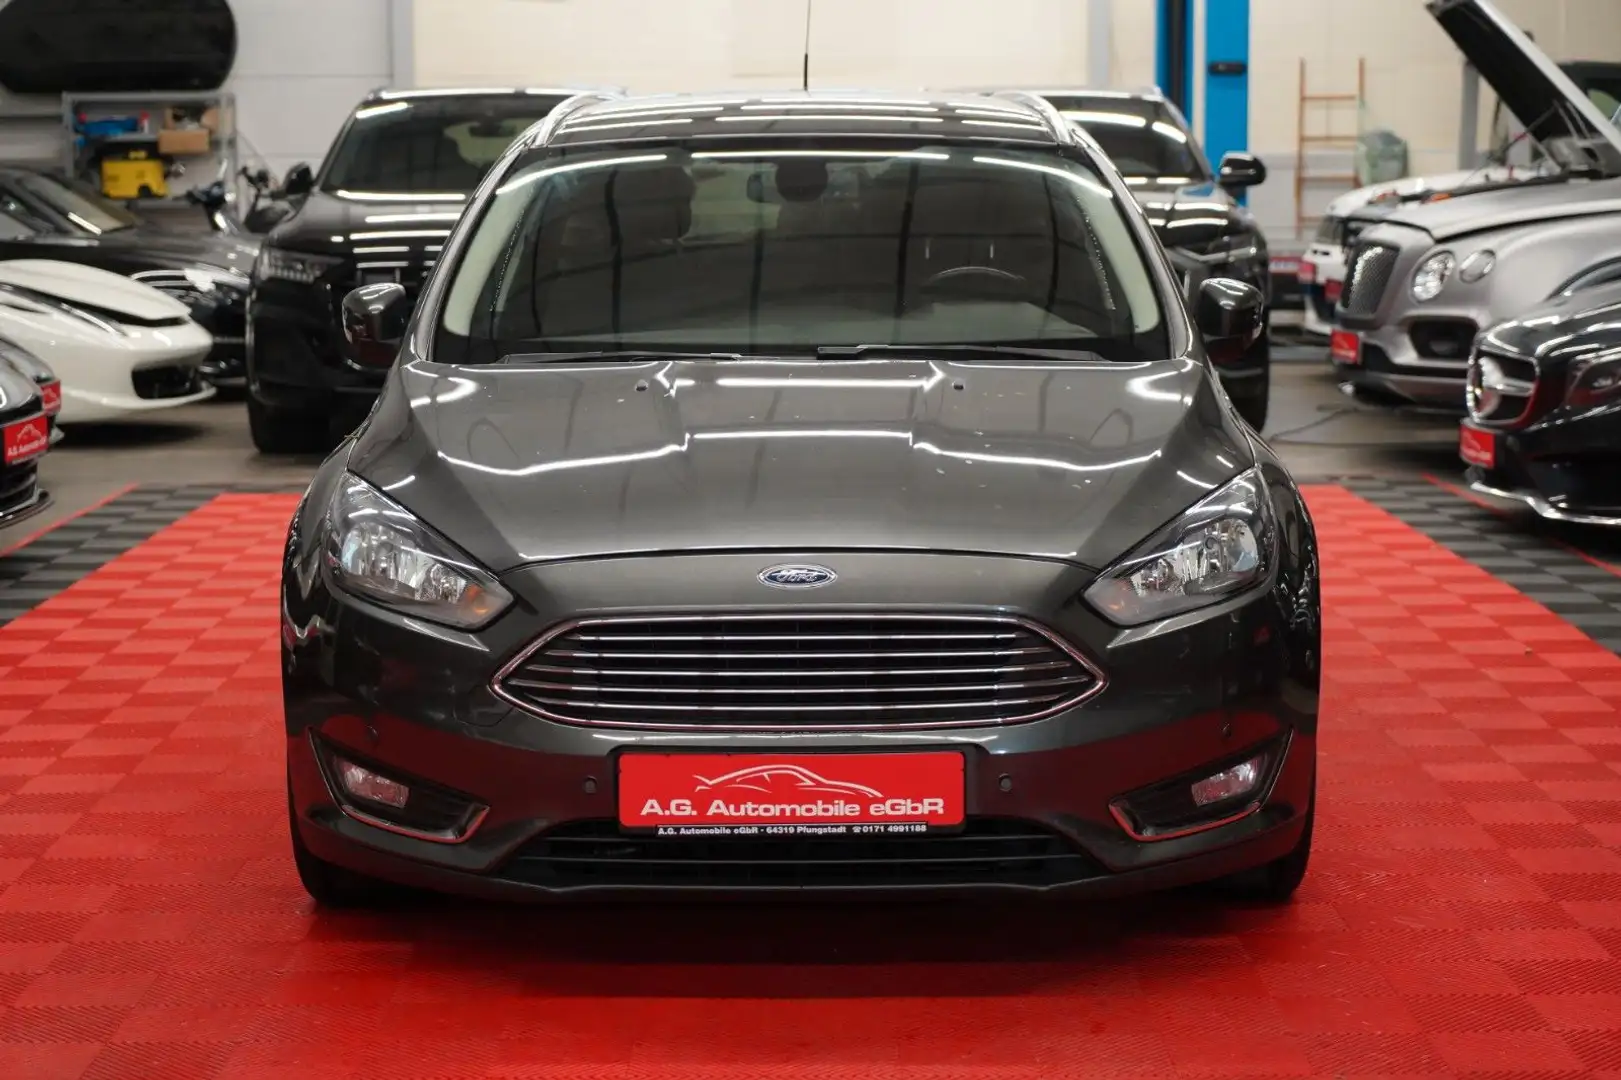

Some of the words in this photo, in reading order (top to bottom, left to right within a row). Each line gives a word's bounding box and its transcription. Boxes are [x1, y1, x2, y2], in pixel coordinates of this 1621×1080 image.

[774, 569, 823, 582] Ford
[640, 798, 698, 816] A.G.
[706, 799, 861, 817] Automobile
[869, 797, 945, 816] eGbR
[657, 827, 678, 835] A.G.
[680, 826, 732, 835] Automobile
[733, 826, 759, 834] eGbR
[766, 826, 795, 834] 64319
[796, 825, 847, 835] Pfungstadt
[862, 825, 885, 833] 0171
[887, 824, 927, 833] 4991188
